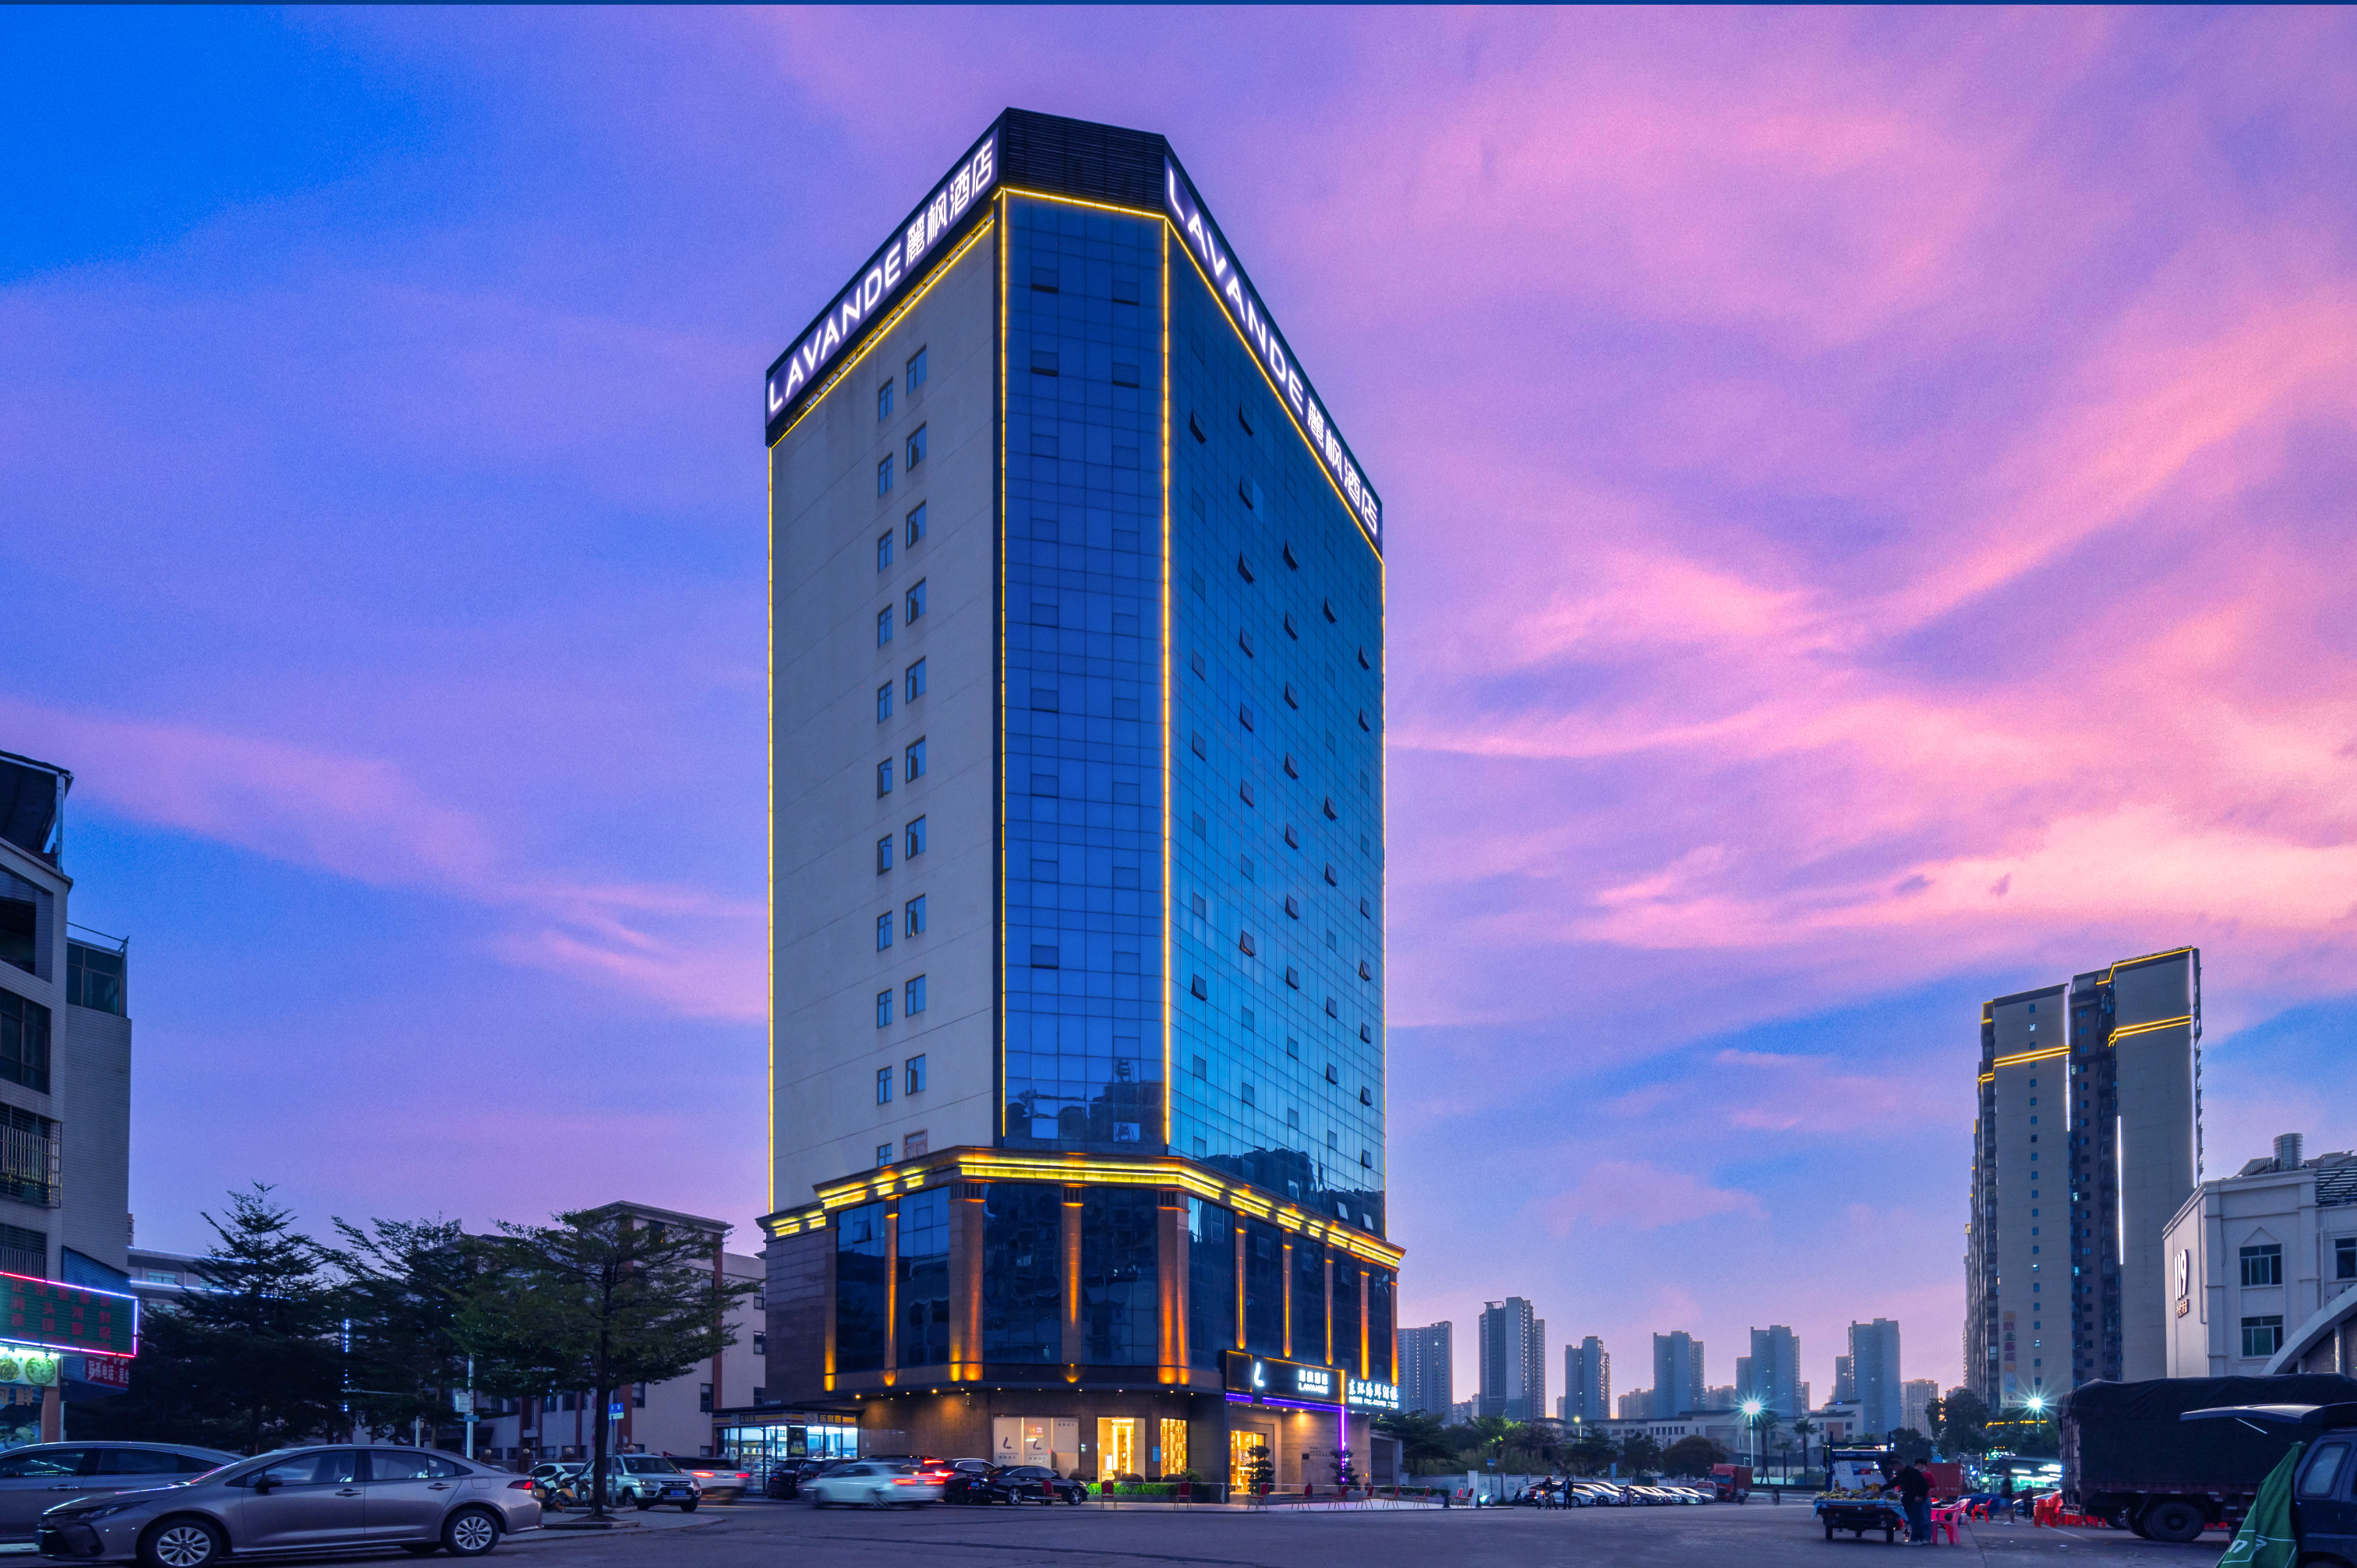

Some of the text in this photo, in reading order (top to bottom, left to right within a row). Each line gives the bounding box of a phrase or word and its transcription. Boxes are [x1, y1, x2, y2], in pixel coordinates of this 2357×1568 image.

[769, 241, 901, 412] LAVANDE
[1168, 167, 1304, 416] LAVANDE
[2174, 1248, 2189, 1301] 119
